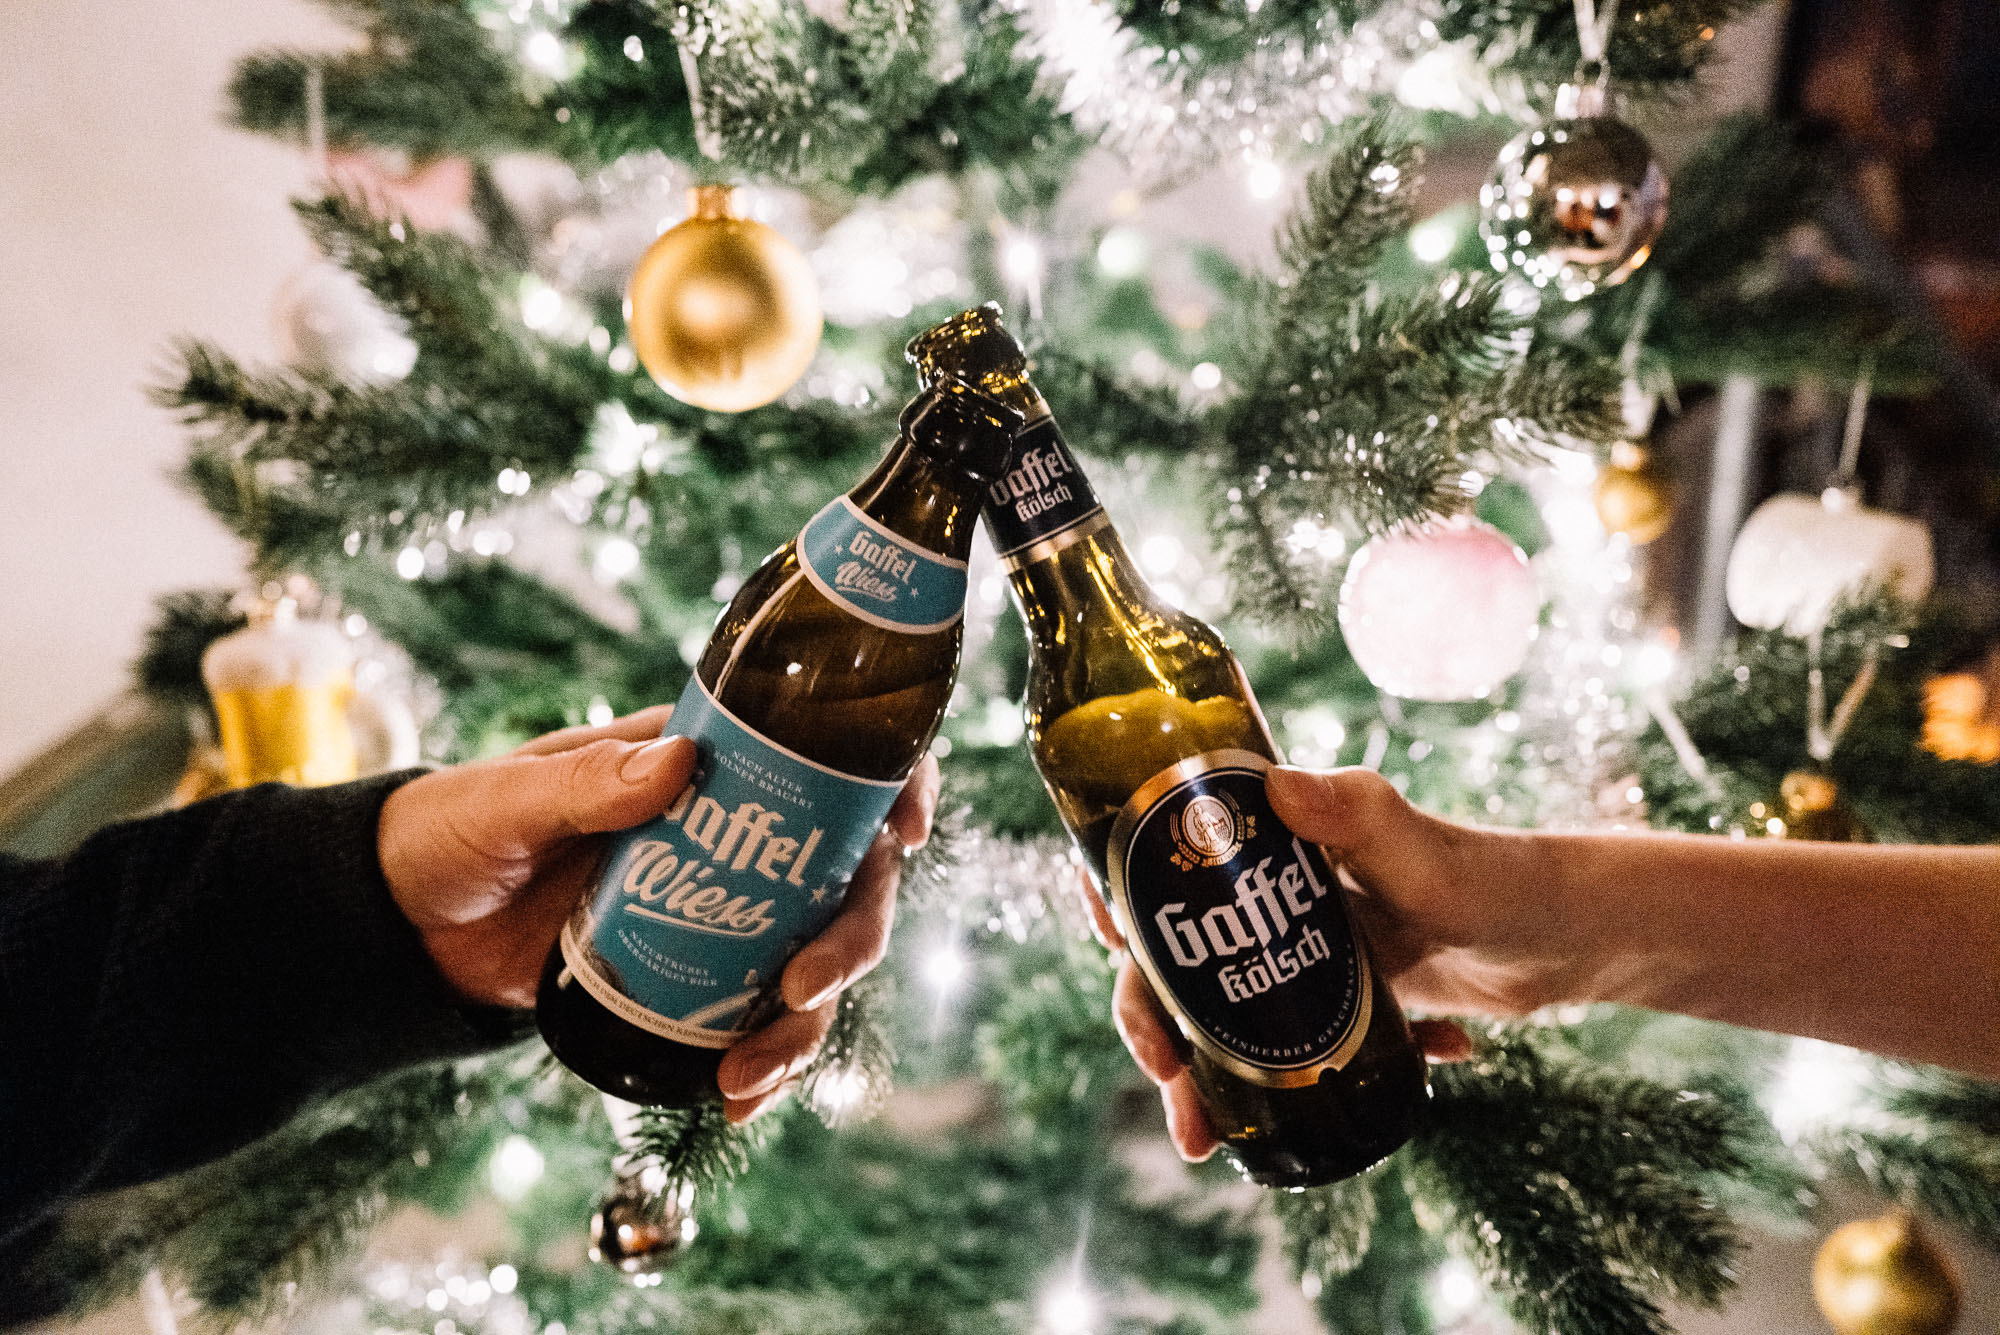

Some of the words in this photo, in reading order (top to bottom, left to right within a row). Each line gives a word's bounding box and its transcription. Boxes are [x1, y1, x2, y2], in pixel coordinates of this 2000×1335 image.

[835, 561, 897, 602] Wiess
[849, 531, 917, 585] Gaffel
[732, 751, 763, 774] NACH
[766, 771, 803, 793] ALTER
[623, 839, 776, 936] Wiess
[1154, 837, 1328, 968] Gaffel
[1217, 924, 1331, 1003] Kölsch
